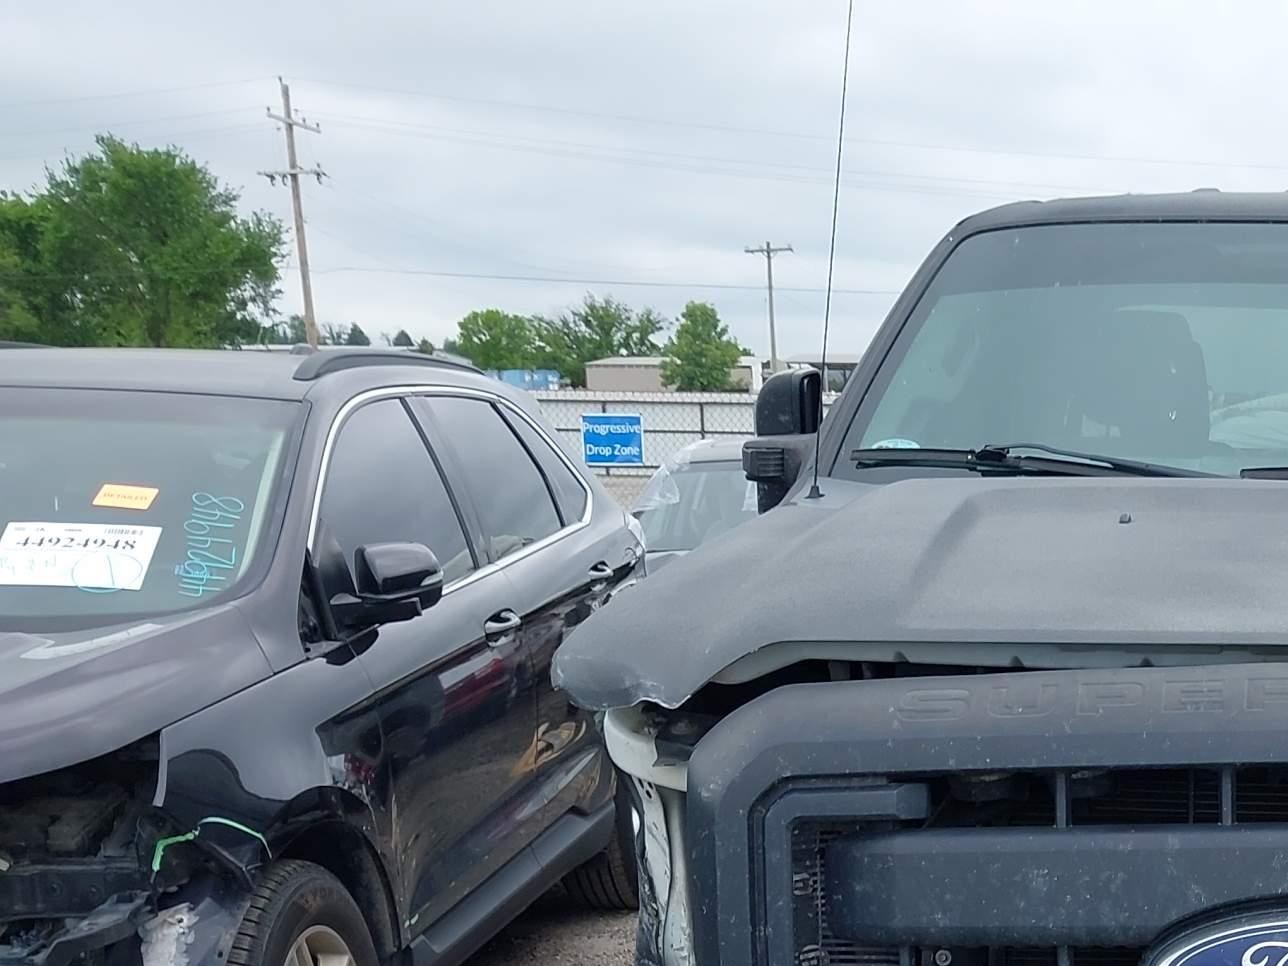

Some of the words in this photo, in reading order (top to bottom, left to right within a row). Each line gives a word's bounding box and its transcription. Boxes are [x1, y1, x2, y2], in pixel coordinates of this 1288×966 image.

[583, 422, 641, 436] Progressive
[586, 443, 612, 457] Drop
[613, 444, 640, 456] Zone
[16, 535, 137, 550] 44924948
